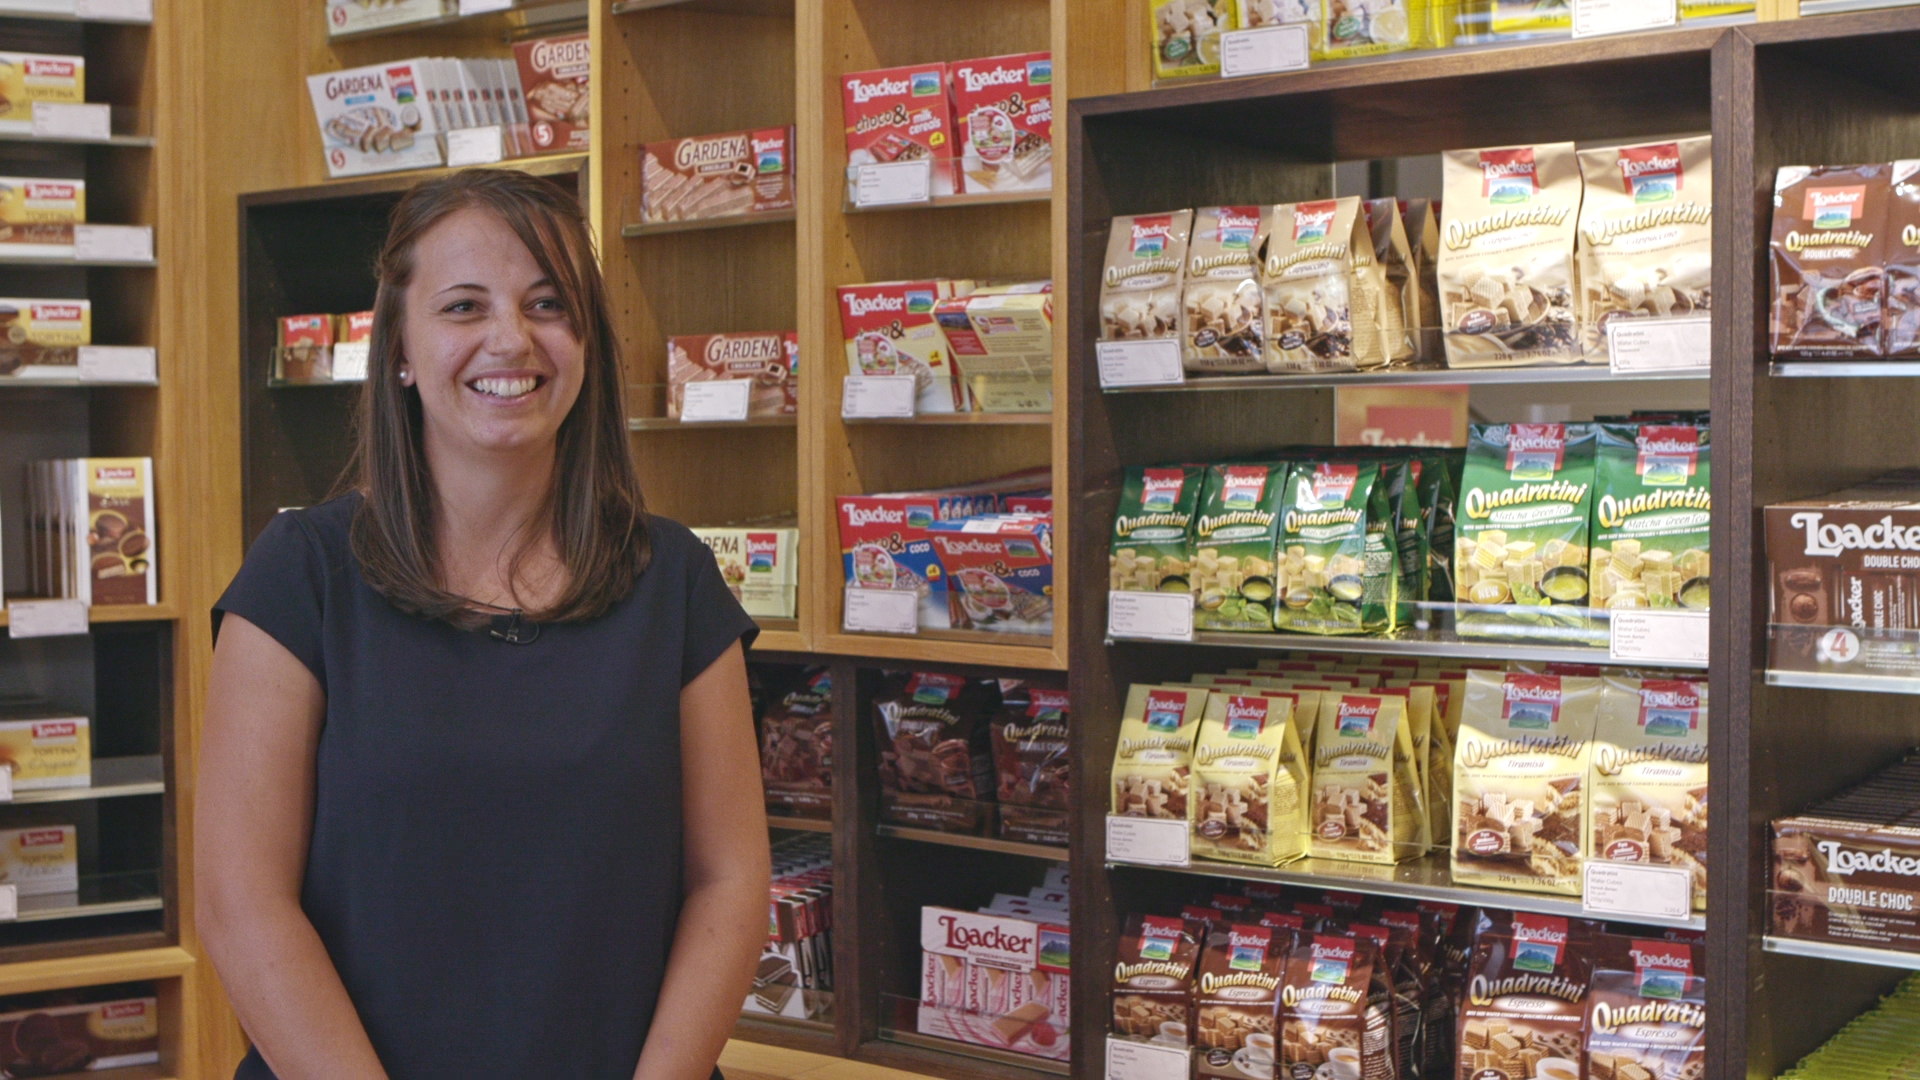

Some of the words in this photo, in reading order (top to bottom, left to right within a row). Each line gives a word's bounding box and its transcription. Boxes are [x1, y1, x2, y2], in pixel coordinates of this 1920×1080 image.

[326, 75, 383, 99] GARDENA
[959, 66, 1025, 91] Loacker
[847, 78, 909, 102] Loacker
[1009, 93, 1026, 114] &
[856, 112, 892, 134] choco
[893, 104, 909, 126] &
[913, 109, 932, 123] milk
[536, 124, 548, 144] 5
[909, 119, 942, 135] cereals
[678, 137, 748, 166] GARDENA
[751, 138, 784, 153] Loacker
[1480, 161, 1534, 178] Loacker
[1618, 156, 1679, 177] Loacker
[1810, 191, 1860, 206] Loacker
[1218, 215, 1259, 227] Loacker
[1293, 209, 1335, 226] Loacker
[1445, 204, 1570, 250] Quadratini
[1586, 201, 1712, 246] Quadratini
[1131, 224, 1170, 238] Loacker
[1785, 230, 1873, 252] Quadratini
[1268, 244, 1346, 277] Quadratini
[1804, 249, 1831, 259] DOUBLE
[1833, 249, 1853, 259] CHOC
[1106, 258, 1181, 287] Quadratini
[844, 293, 904, 316] Loacker
[890, 320, 905, 339] &
[708, 337, 780, 362] GARDENA
[1505, 433, 1563, 452] Loacker
[1635, 435, 1696, 455] Loacker
[1143, 476, 1183, 490] Loacker
[1224, 473, 1266, 488] Loacker
[1313, 472, 1355, 486] Loacker
[1465, 480, 1587, 519] Quadratini
[843, 503, 904, 526] Loacker
[1198, 509, 1276, 537] Quadratini
[1285, 507, 1362, 533] Quadratini
[1494, 511, 1527, 520] Matcha
[1532, 509, 1554, 518] Green
[1627, 520, 1660, 529] Matcha
[1666, 516, 1690, 525] Green
[1692, 513, 1706, 522] Tea
[1116, 512, 1190, 537] Quadratini
[890, 532, 906, 553] &
[935, 537, 1002, 555] Loacker
[1864, 555, 1899, 568] DOUBLE
[1478, 586, 1498, 599] NEW
[1831, 632, 1849, 657] 4
[1502, 682, 1561, 701] Loacker
[1639, 689, 1698, 708] Loacker
[1145, 696, 1185, 711] Loacker
[1227, 703, 1267, 718] Loacker
[1337, 702, 1377, 716] Loacker
[1119, 736, 1190, 758] Quadratini
[1198, 743, 1275, 766] Quadratini
[1318, 741, 1389, 767] Quadratini
[1461, 734, 1585, 768] Quadratini
[1508, 760, 1545, 768] Tiramisù
[1642, 767, 1682, 776] Tiramisù
[1828, 887, 1877, 907] DOUBLE
[1879, 892, 1913, 911] CHOC
[938, 915, 1033, 954] Loacker
[1142, 922, 1181, 938] Loacker
[1228, 931, 1270, 947] Loacker
[1512, 921, 1566, 943] Loacker
[1311, 943, 1353, 959] Loacker
[1629, 950, 1690, 969] Loacker
[1115, 961, 1189, 983] Quadratini
[1138, 977, 1168, 987] Espresso
[1201, 972, 1280, 994] Quadratini
[1470, 973, 1586, 1006] Quadratini
[1228, 989, 1258, 998] Espresso
[1282, 984, 1362, 1008] Quadratini
[1311, 1002, 1342, 1011] Espresso
[1508, 999, 1546, 1009] Espresso
[1635, 1027, 1678, 1039] Espresso
